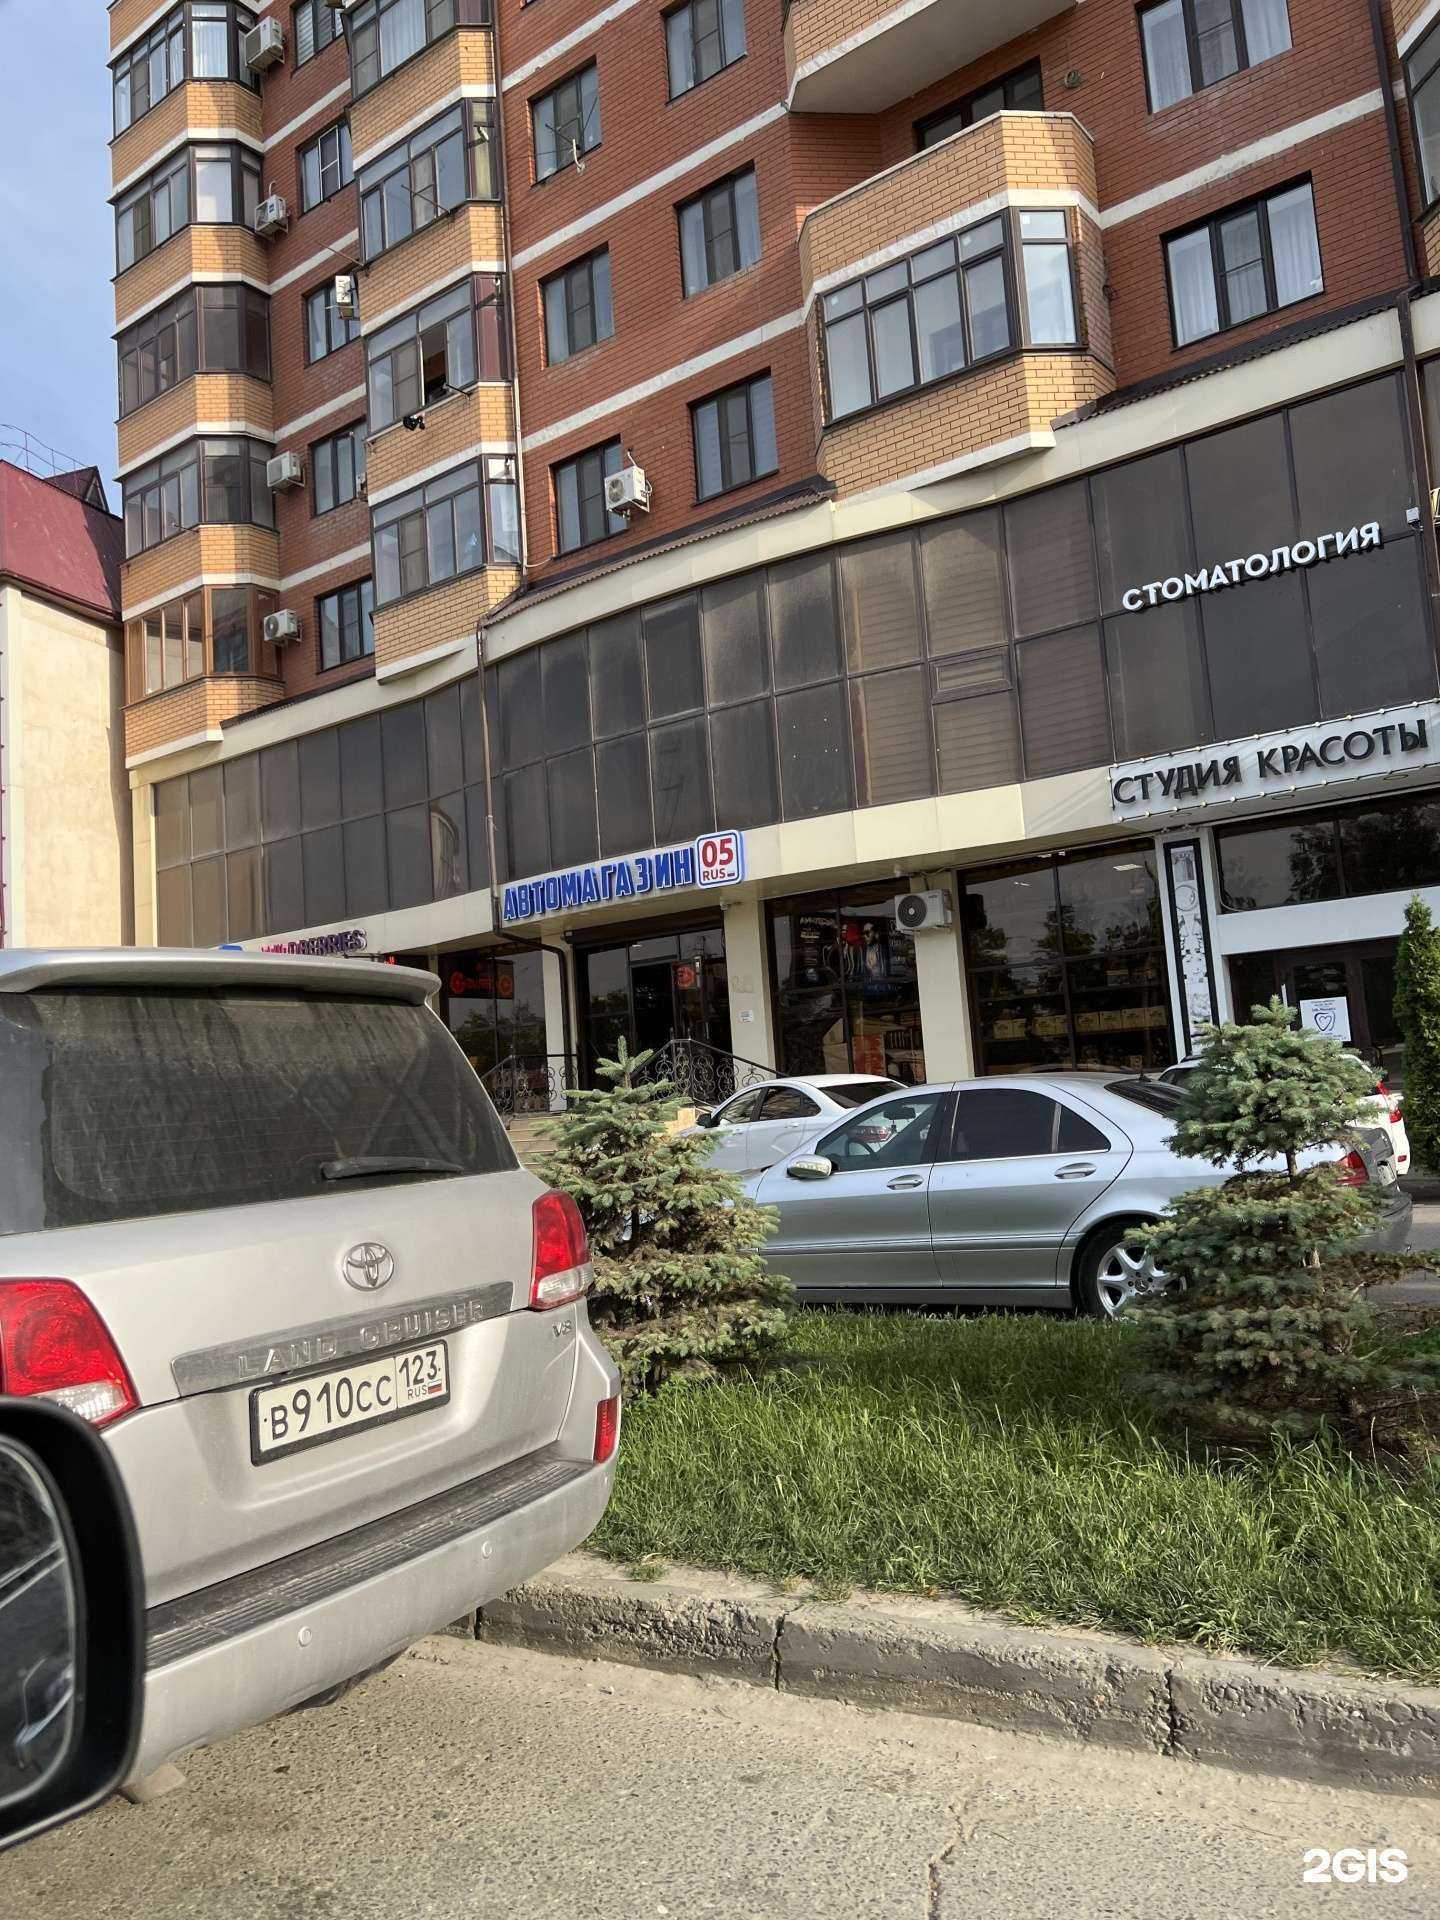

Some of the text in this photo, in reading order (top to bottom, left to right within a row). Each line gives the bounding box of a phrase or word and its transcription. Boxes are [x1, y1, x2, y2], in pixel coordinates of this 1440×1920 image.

[1122, 521, 1381, 611] СТОМАТОЛОГИЯ
[1113, 719, 1430, 803] СТУДИЯ КРАСОТЫ
[701, 838, 734, 867] 05
[702, 868, 727, 881] RUS
[503, 848, 694, 921] АВТОМАГАЗИН
[237, 1300, 485, 1380] LAND CRUISER
[399, 1350, 437, 1387] 123
[407, 1385, 427, 1400] RUS
